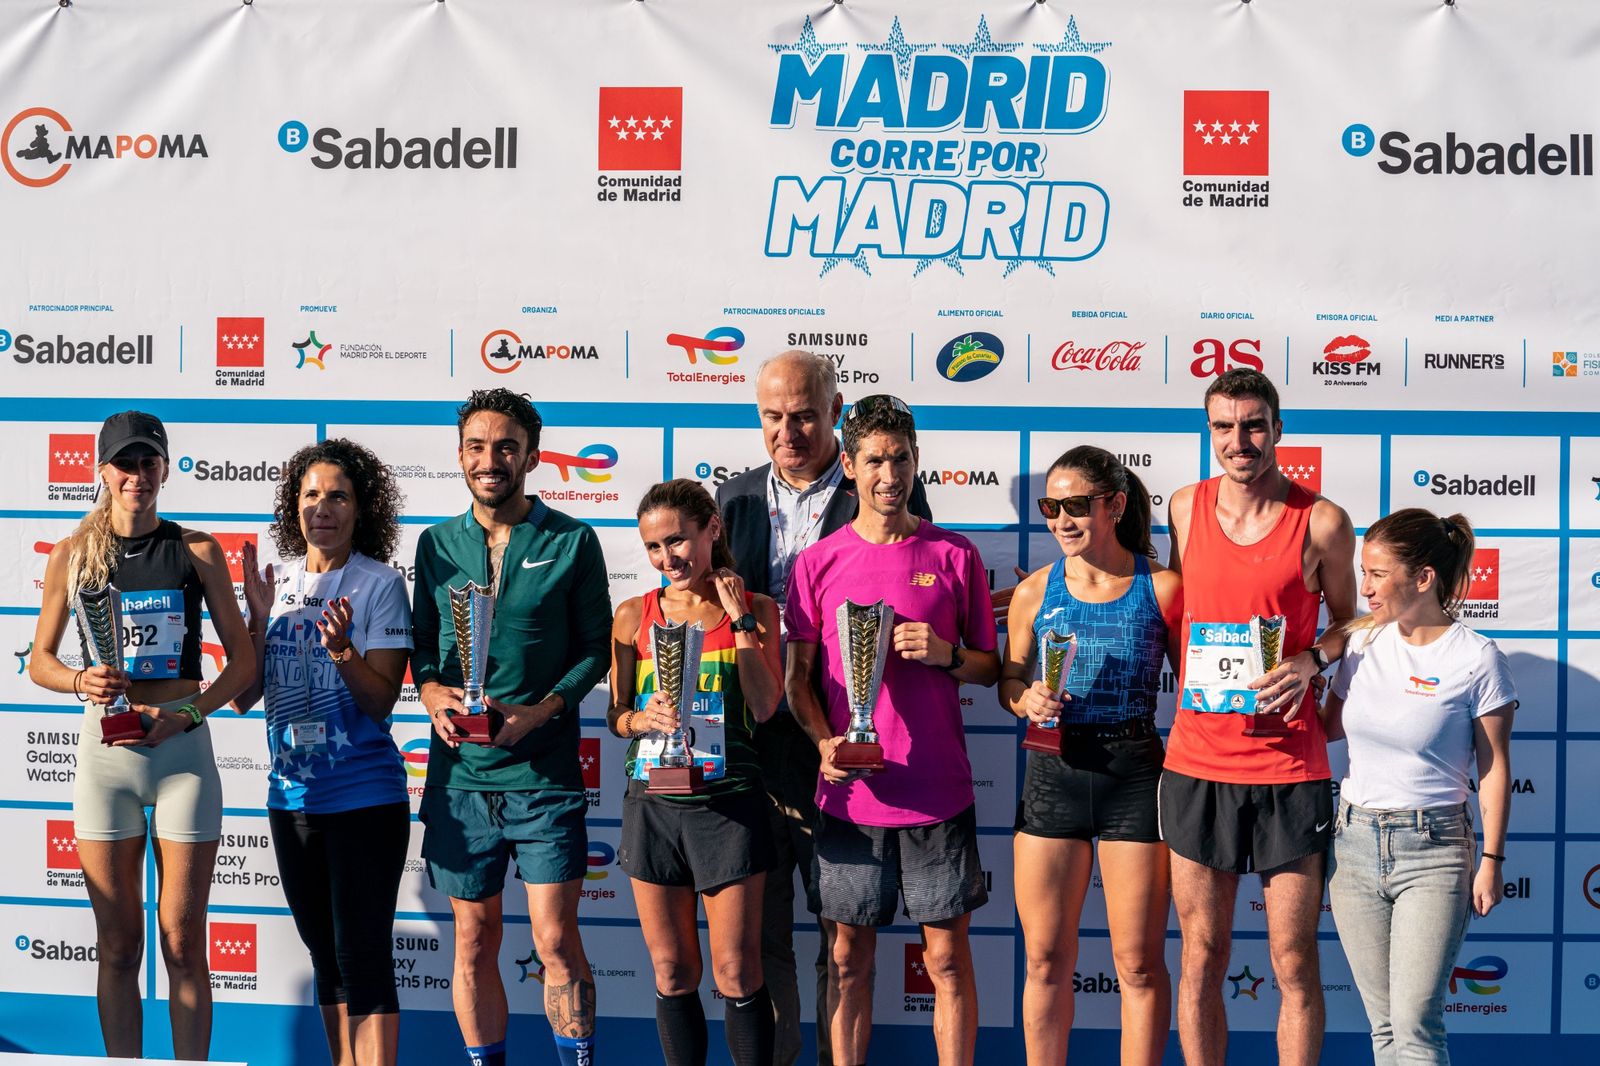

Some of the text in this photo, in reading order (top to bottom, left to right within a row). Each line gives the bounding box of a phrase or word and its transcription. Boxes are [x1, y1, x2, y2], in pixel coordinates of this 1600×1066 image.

[769, 53, 1109, 134] MADRID
[65, 134, 209, 160] MAPOMA
[310, 126, 518, 170] Sabadell
[831, 138, 1042, 174] CORRE POR
[1377, 131, 1594, 177] Sabadell
[598, 175, 682, 188] Comunidad
[1182, 180, 1270, 193] Comunidad
[597, 188, 682, 202] de Madrid
[1182, 194, 1270, 208] de Madrid
[765, 176, 1110, 261] MADRID
[300, 305, 337, 313] PROMUEVE
[522, 306, 558, 314] ORGANIZA
[723, 307, 826, 316] PATROCINADORES OFICIALES
[937, 309, 1003, 318] ALIMENTO OFICIAL
[1099, 311, 1128, 319] OFICIAL
[1200, 312, 1255, 320] DIARIO OFICIAL
[1349, 314, 1378, 322] OFICIAL
[1460, 315, 1494, 323] PARTNER
[788, 332, 868, 346] SAMSUNG
[13, 333, 153, 364] Sabadell
[340, 343, 382, 352] FUNDACIÓN
[518, 345, 599, 359] MAPOMA
[394, 352, 427, 360] DEPORTE
[1190, 338, 1264, 378] as
[215, 369, 265, 378] Comunidad
[1312, 361, 1381, 376] KISS FM
[215, 378, 265, 386] de Madrid
[667, 372, 746, 385] TotalEnergies
[853, 370, 880, 384] Pro
[48, 484, 95, 493] Comunidad
[1430, 473, 1536, 496] Sabadell
[48, 493, 94, 501] de Madrid
[539, 490, 619, 503] TotalEnergies
[1463, 610, 1499, 618] Madrid
[27, 732, 80, 745] SAMSU
[27, 768, 75, 782] Watch
[47, 870, 84, 879] Comunid
[254, 873, 279, 886] Pro
[47, 879, 59, 887] de
[209, 973, 257, 982] Comunidad
[606, 970, 635, 978] DEPORTE
[224, 981, 257, 990] Madrid
[424, 976, 449, 989] Pro
[904, 1003, 917, 1012] de
